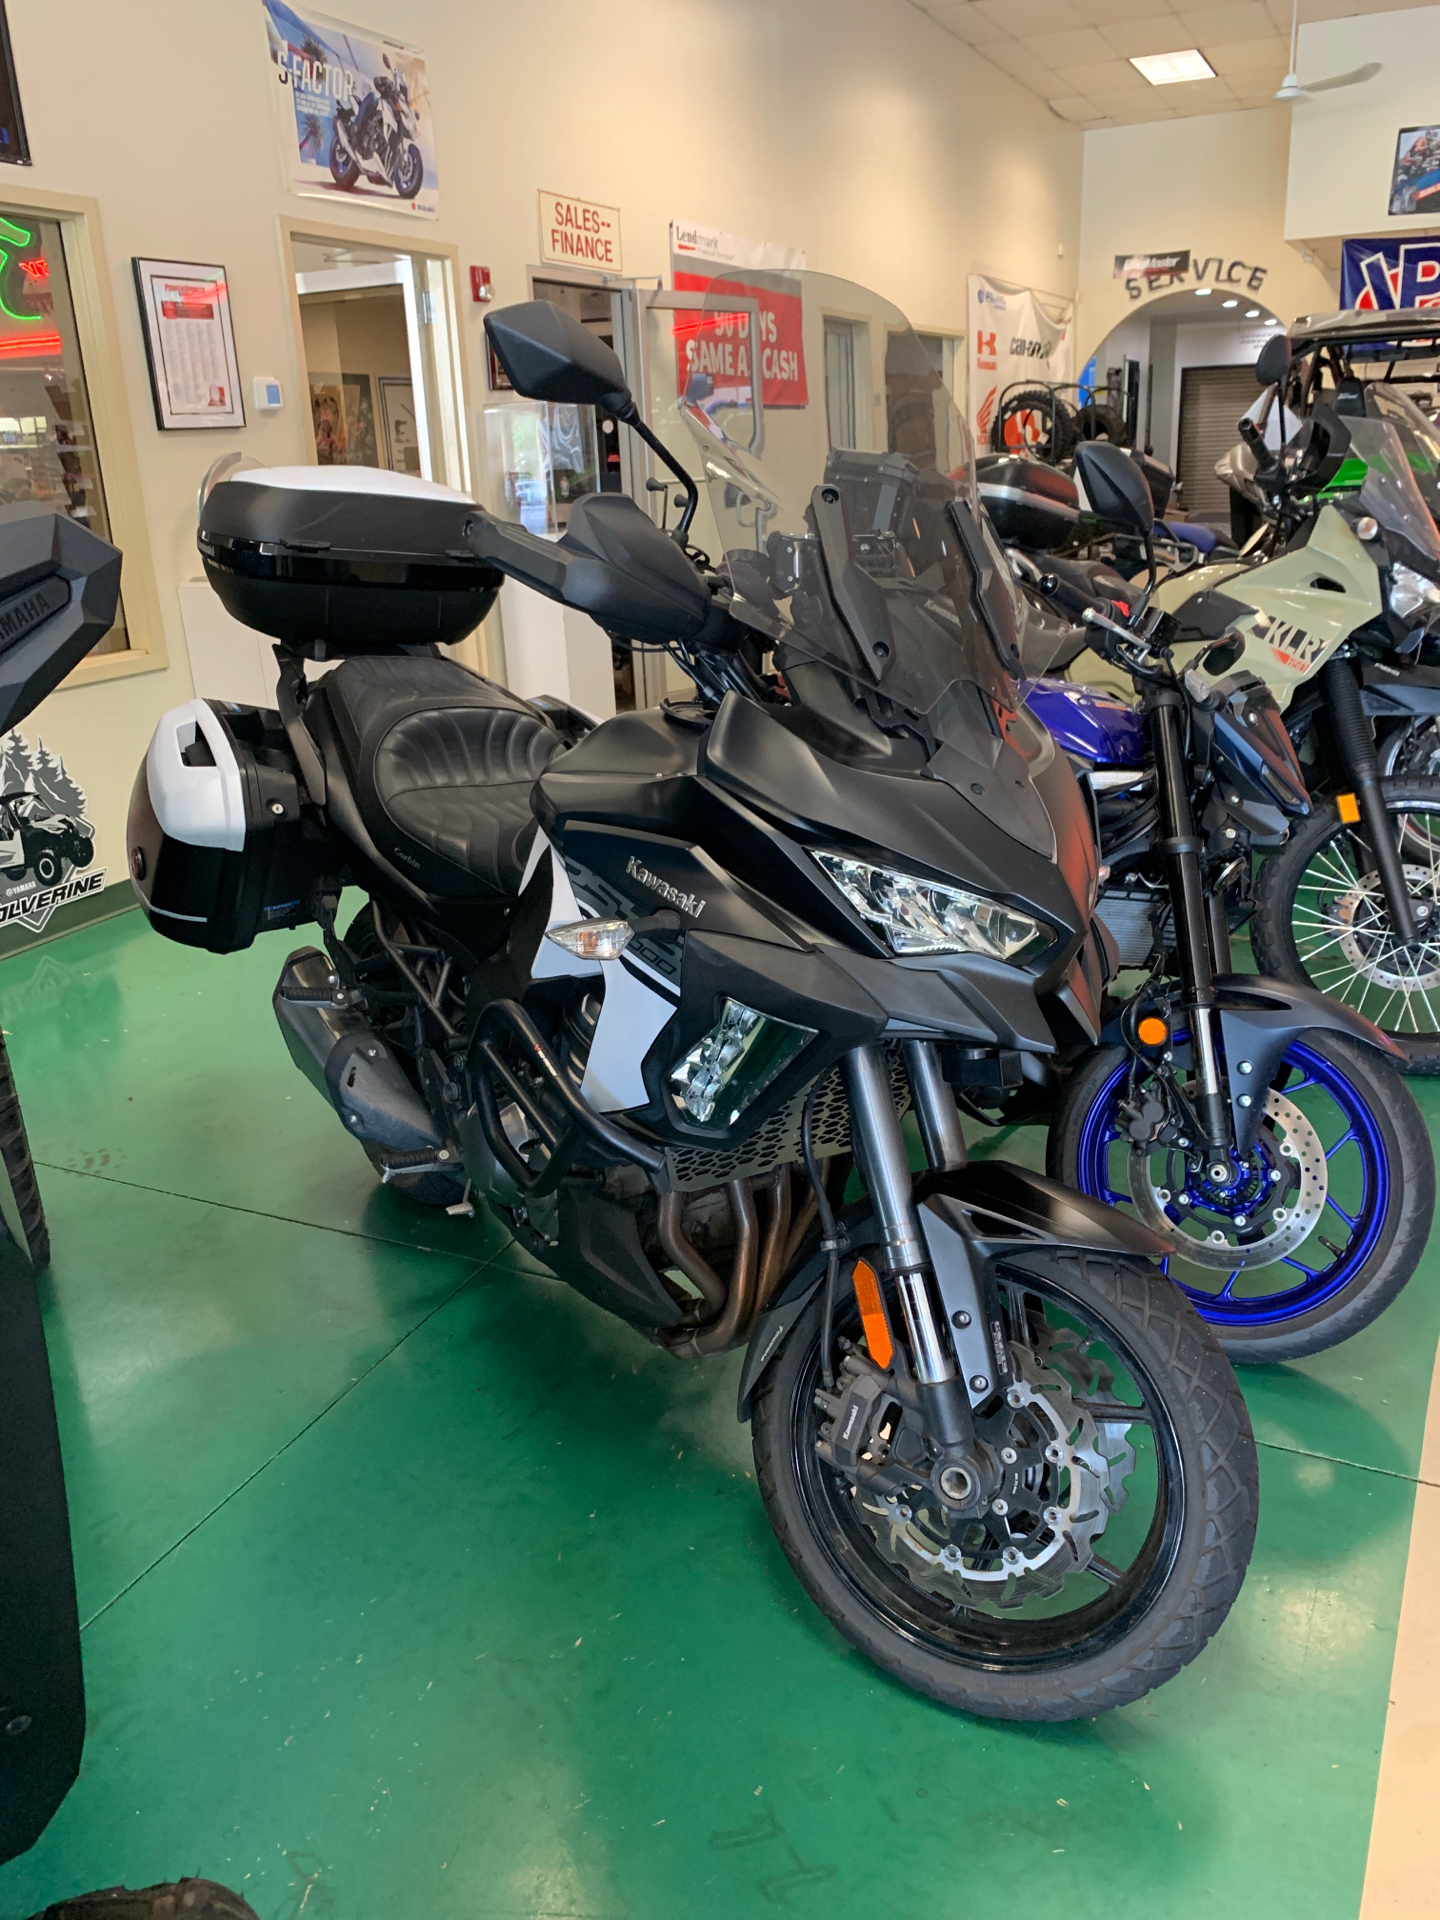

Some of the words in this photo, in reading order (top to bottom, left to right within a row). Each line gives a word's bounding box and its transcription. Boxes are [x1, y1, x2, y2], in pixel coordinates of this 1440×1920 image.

[277, 50, 354, 101] S-FACTOR
[551, 228, 614, 264] FINANCE
[676, 225, 719, 250] Lendmark
[686, 339, 735, 377] SAME
[762, 347, 799, 382] CASH
[1264, 615, 1321, 665] KLR
[626, 855, 707, 919] Kawasaki
[842, 1404, 859, 1440] Kawasaki
